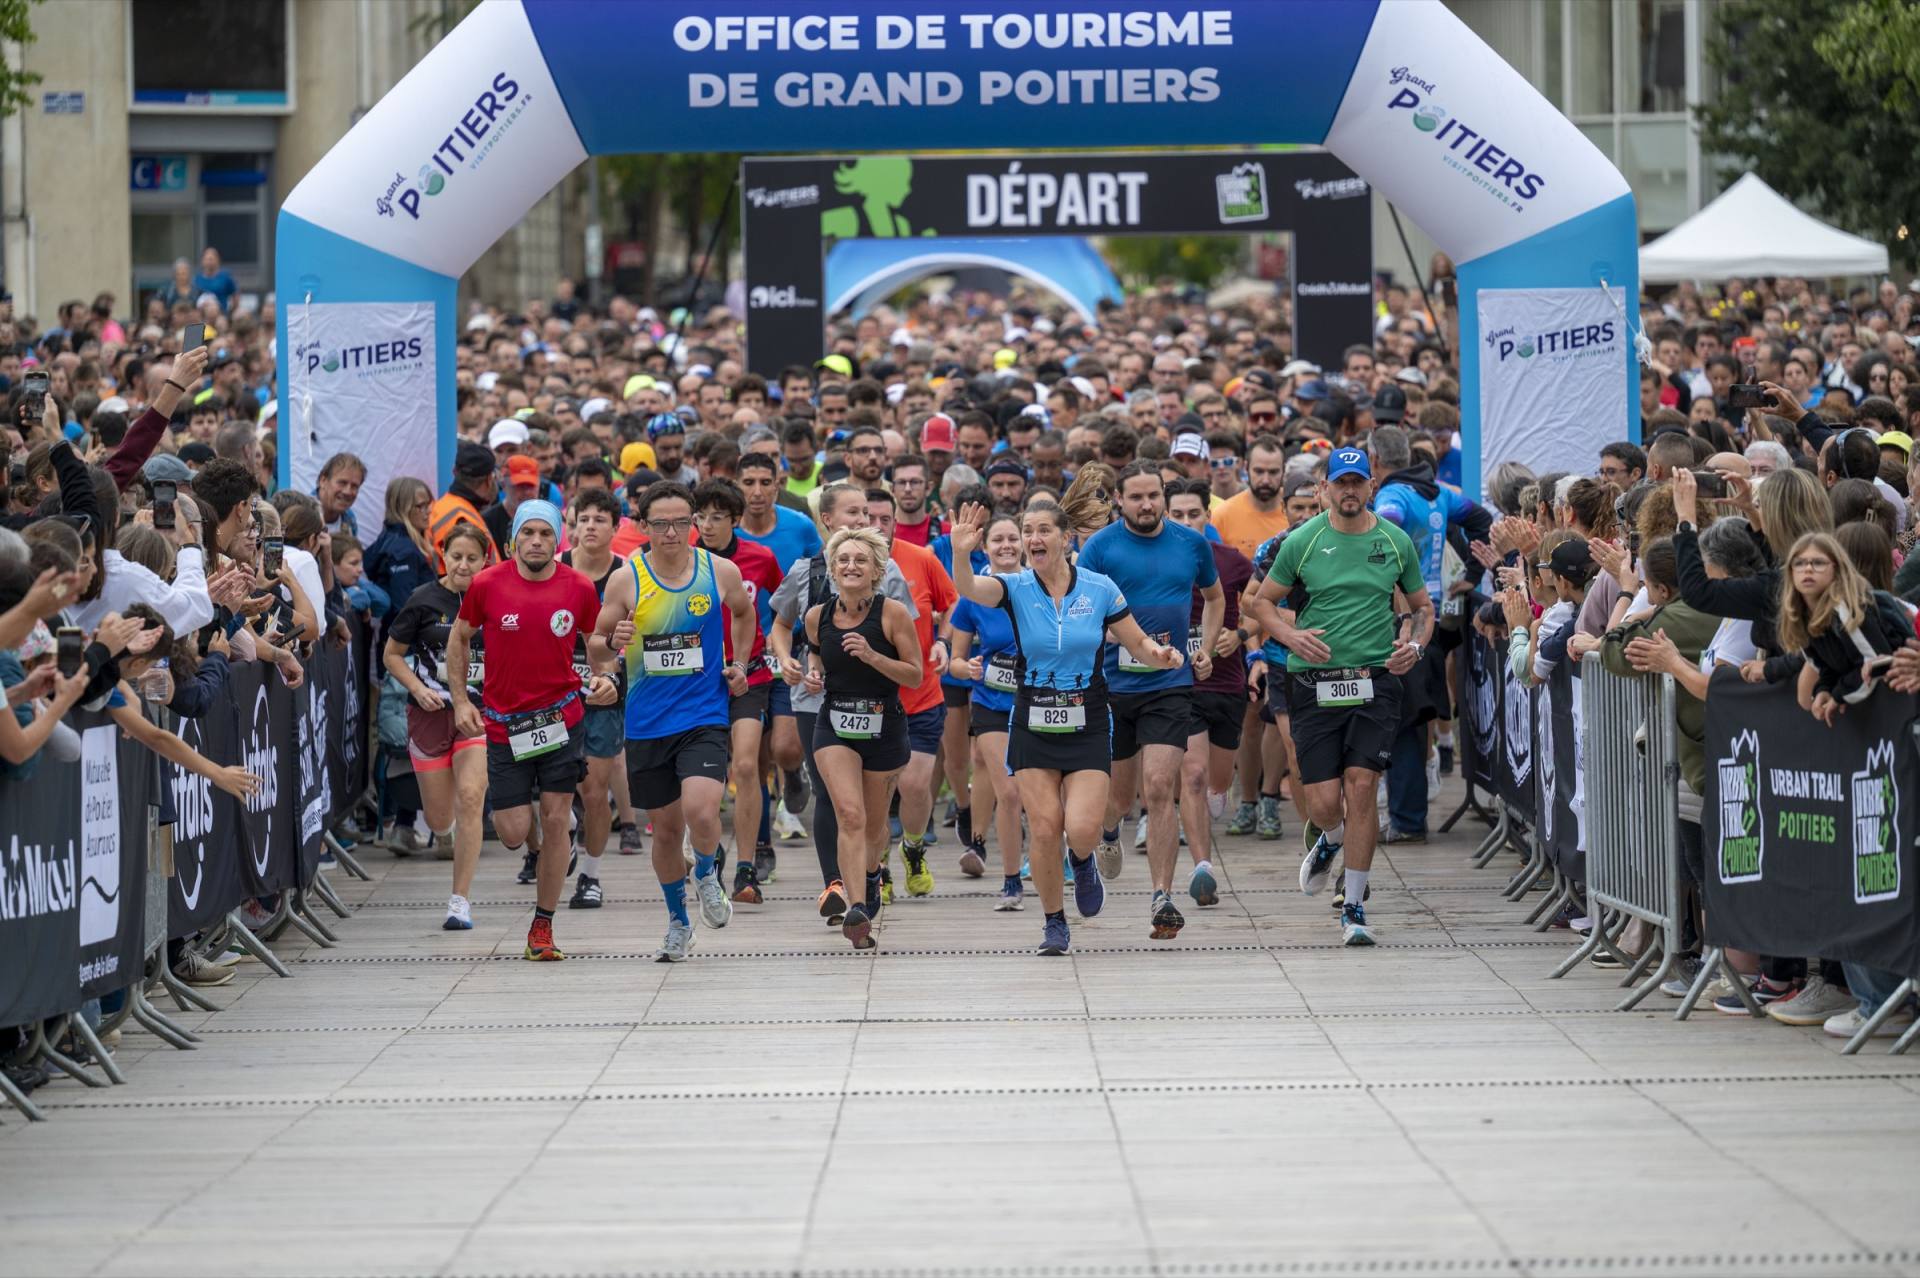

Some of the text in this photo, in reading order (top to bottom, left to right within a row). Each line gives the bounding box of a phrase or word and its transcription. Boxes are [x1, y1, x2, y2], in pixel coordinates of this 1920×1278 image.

[673, 10, 1233, 51] OFFICE DE TOURISME
[688, 67, 1221, 107] DE GRAND POITIERS
[1389, 66, 1436, 96] Grand
[398, 72, 519, 220] POITIERS
[470, 93, 533, 170] VISITPOITIERS.FR
[1387, 88, 1545, 200] POITIERS
[376, 172, 407, 218] Grand
[967, 161, 1149, 227] DÉPART
[1443, 154, 1523, 214] VISITPOITIERS.FR
[308, 337, 422, 375] POITIERS
[1500, 321, 1615, 361] POITIERS
[661, 651, 685, 667] 672
[1331, 682, 1359, 697] 3016
[840, 714, 870, 730] 2473
[1044, 709, 1068, 724] 829
[531, 730, 548, 746] 26
[1770, 768, 1845, 802] URBAN TRAIL
[1778, 811, 1836, 844] POITIERS
